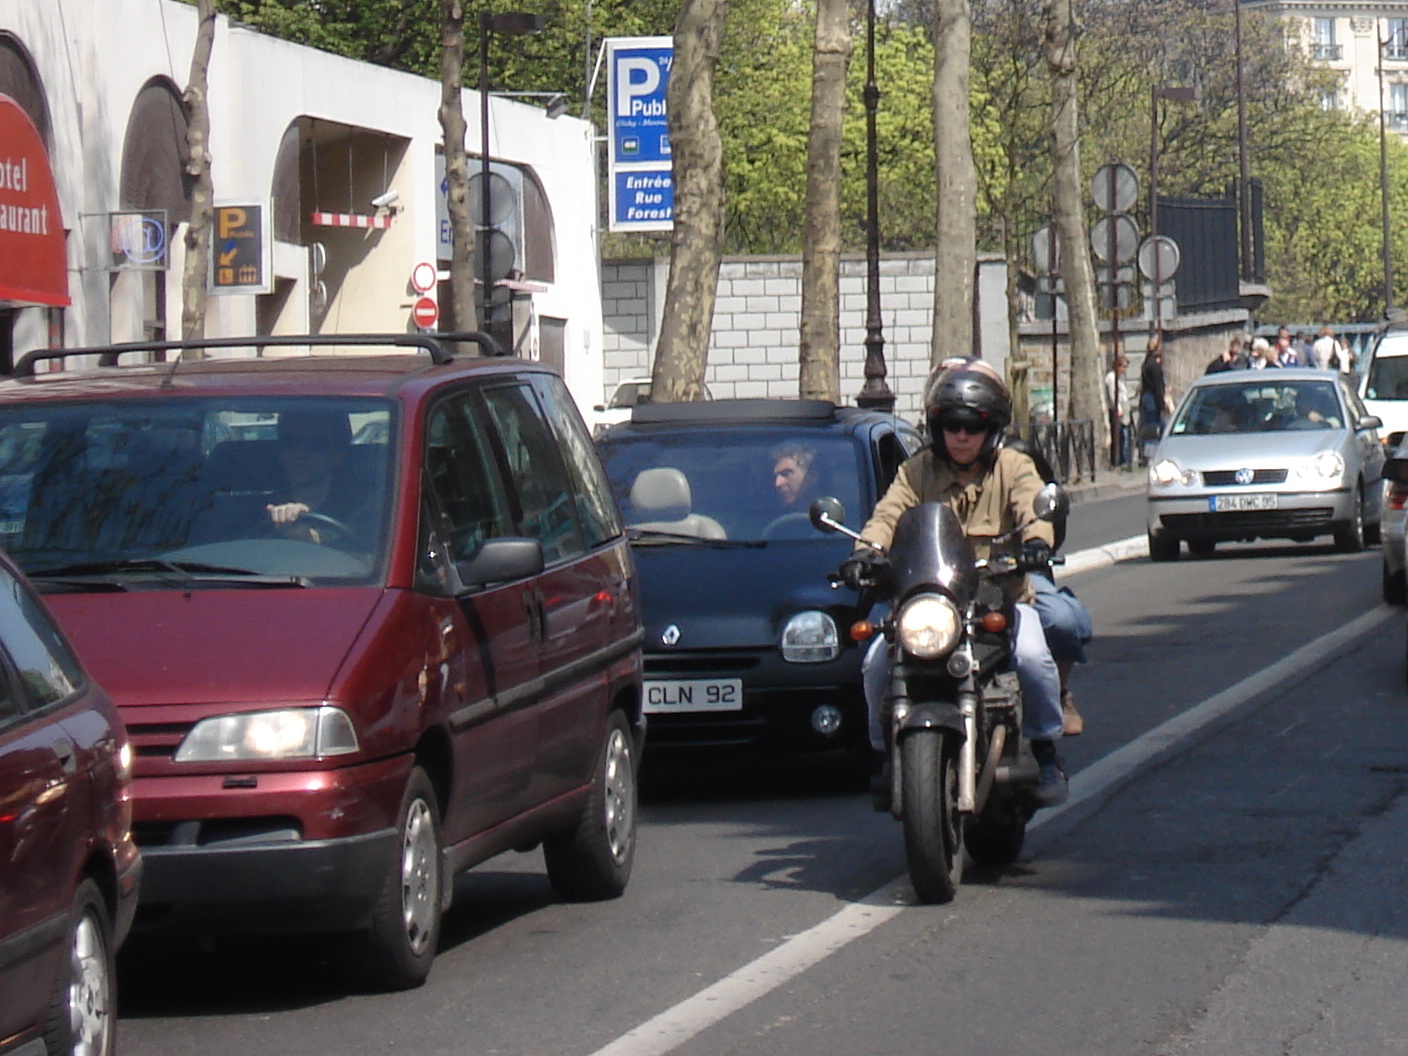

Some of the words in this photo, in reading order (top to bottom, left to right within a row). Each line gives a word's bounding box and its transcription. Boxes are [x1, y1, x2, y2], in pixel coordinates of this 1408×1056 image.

[617, 56, 660, 118] P
[632, 98, 666, 117] Publ
[0, 157, 27, 192] otel
[626, 174, 672, 190] Entrée
[635, 191, 662, 204] Rue
[0, 203, 48, 236] aurant
[219, 208, 246, 239] P
[627, 206, 672, 220] Forest
[648, 686, 693, 705] CLN
[706, 684, 735, 704] 92
